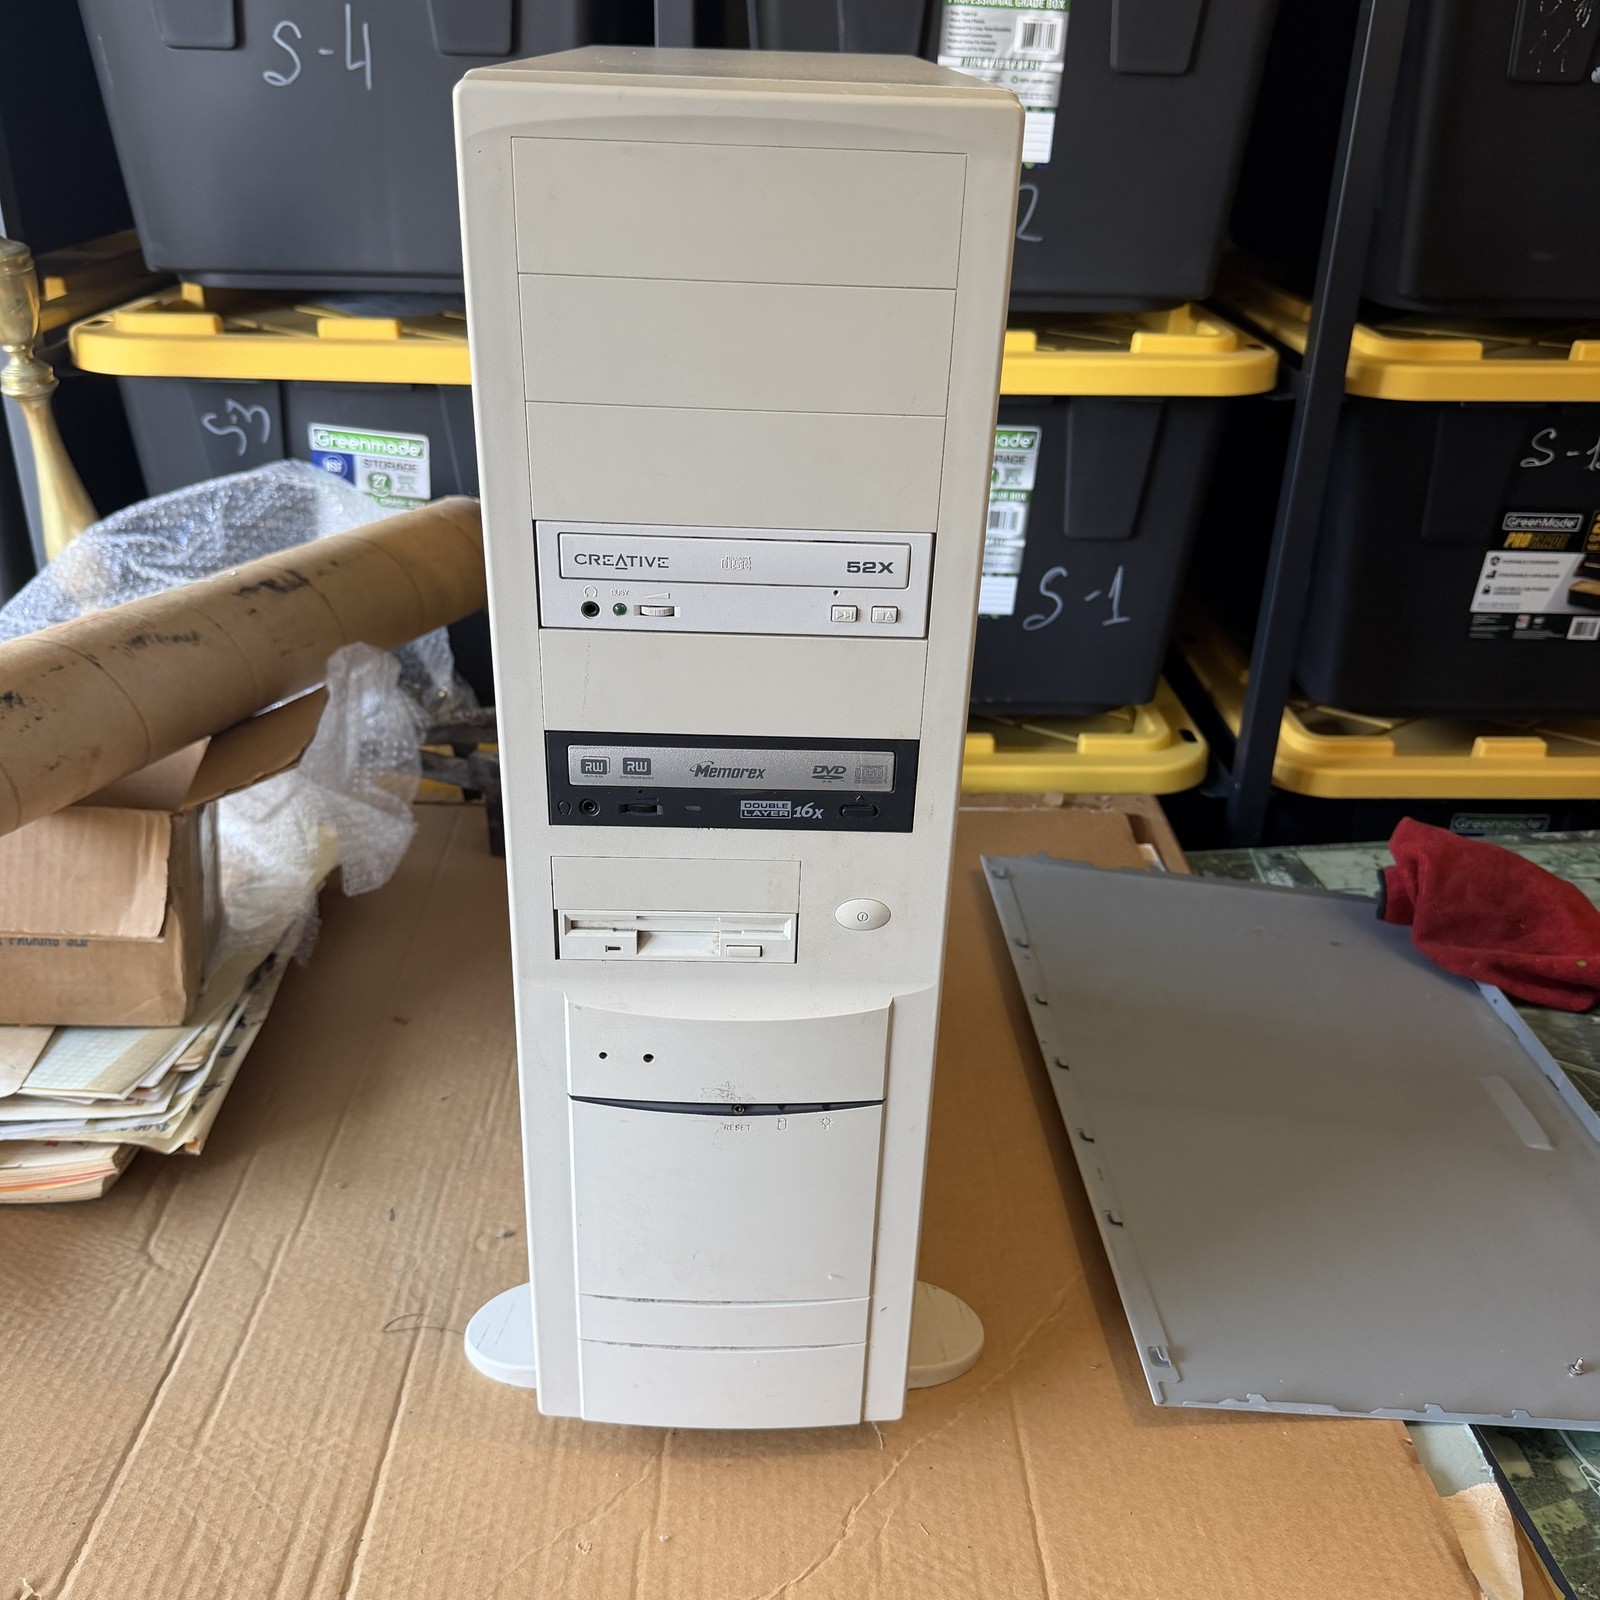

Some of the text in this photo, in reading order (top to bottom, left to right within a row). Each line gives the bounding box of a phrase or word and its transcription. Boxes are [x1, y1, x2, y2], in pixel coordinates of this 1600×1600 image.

[263, 4, 372, 91] S-4
[1520, 427, 1600, 471] S-1
[574, 553, 670, 570] CREATIVE
[847, 561, 895, 575] 52X
[610, 589, 630, 597] BUSY
[1022, 566, 1130, 631] S-1
[585, 761, 604, 772] RW
[626, 761, 648, 772] RW
[690, 760, 767, 779] Memorex
[812, 765, 847, 777] DVD
[744, 802, 789, 810] DOUBLE
